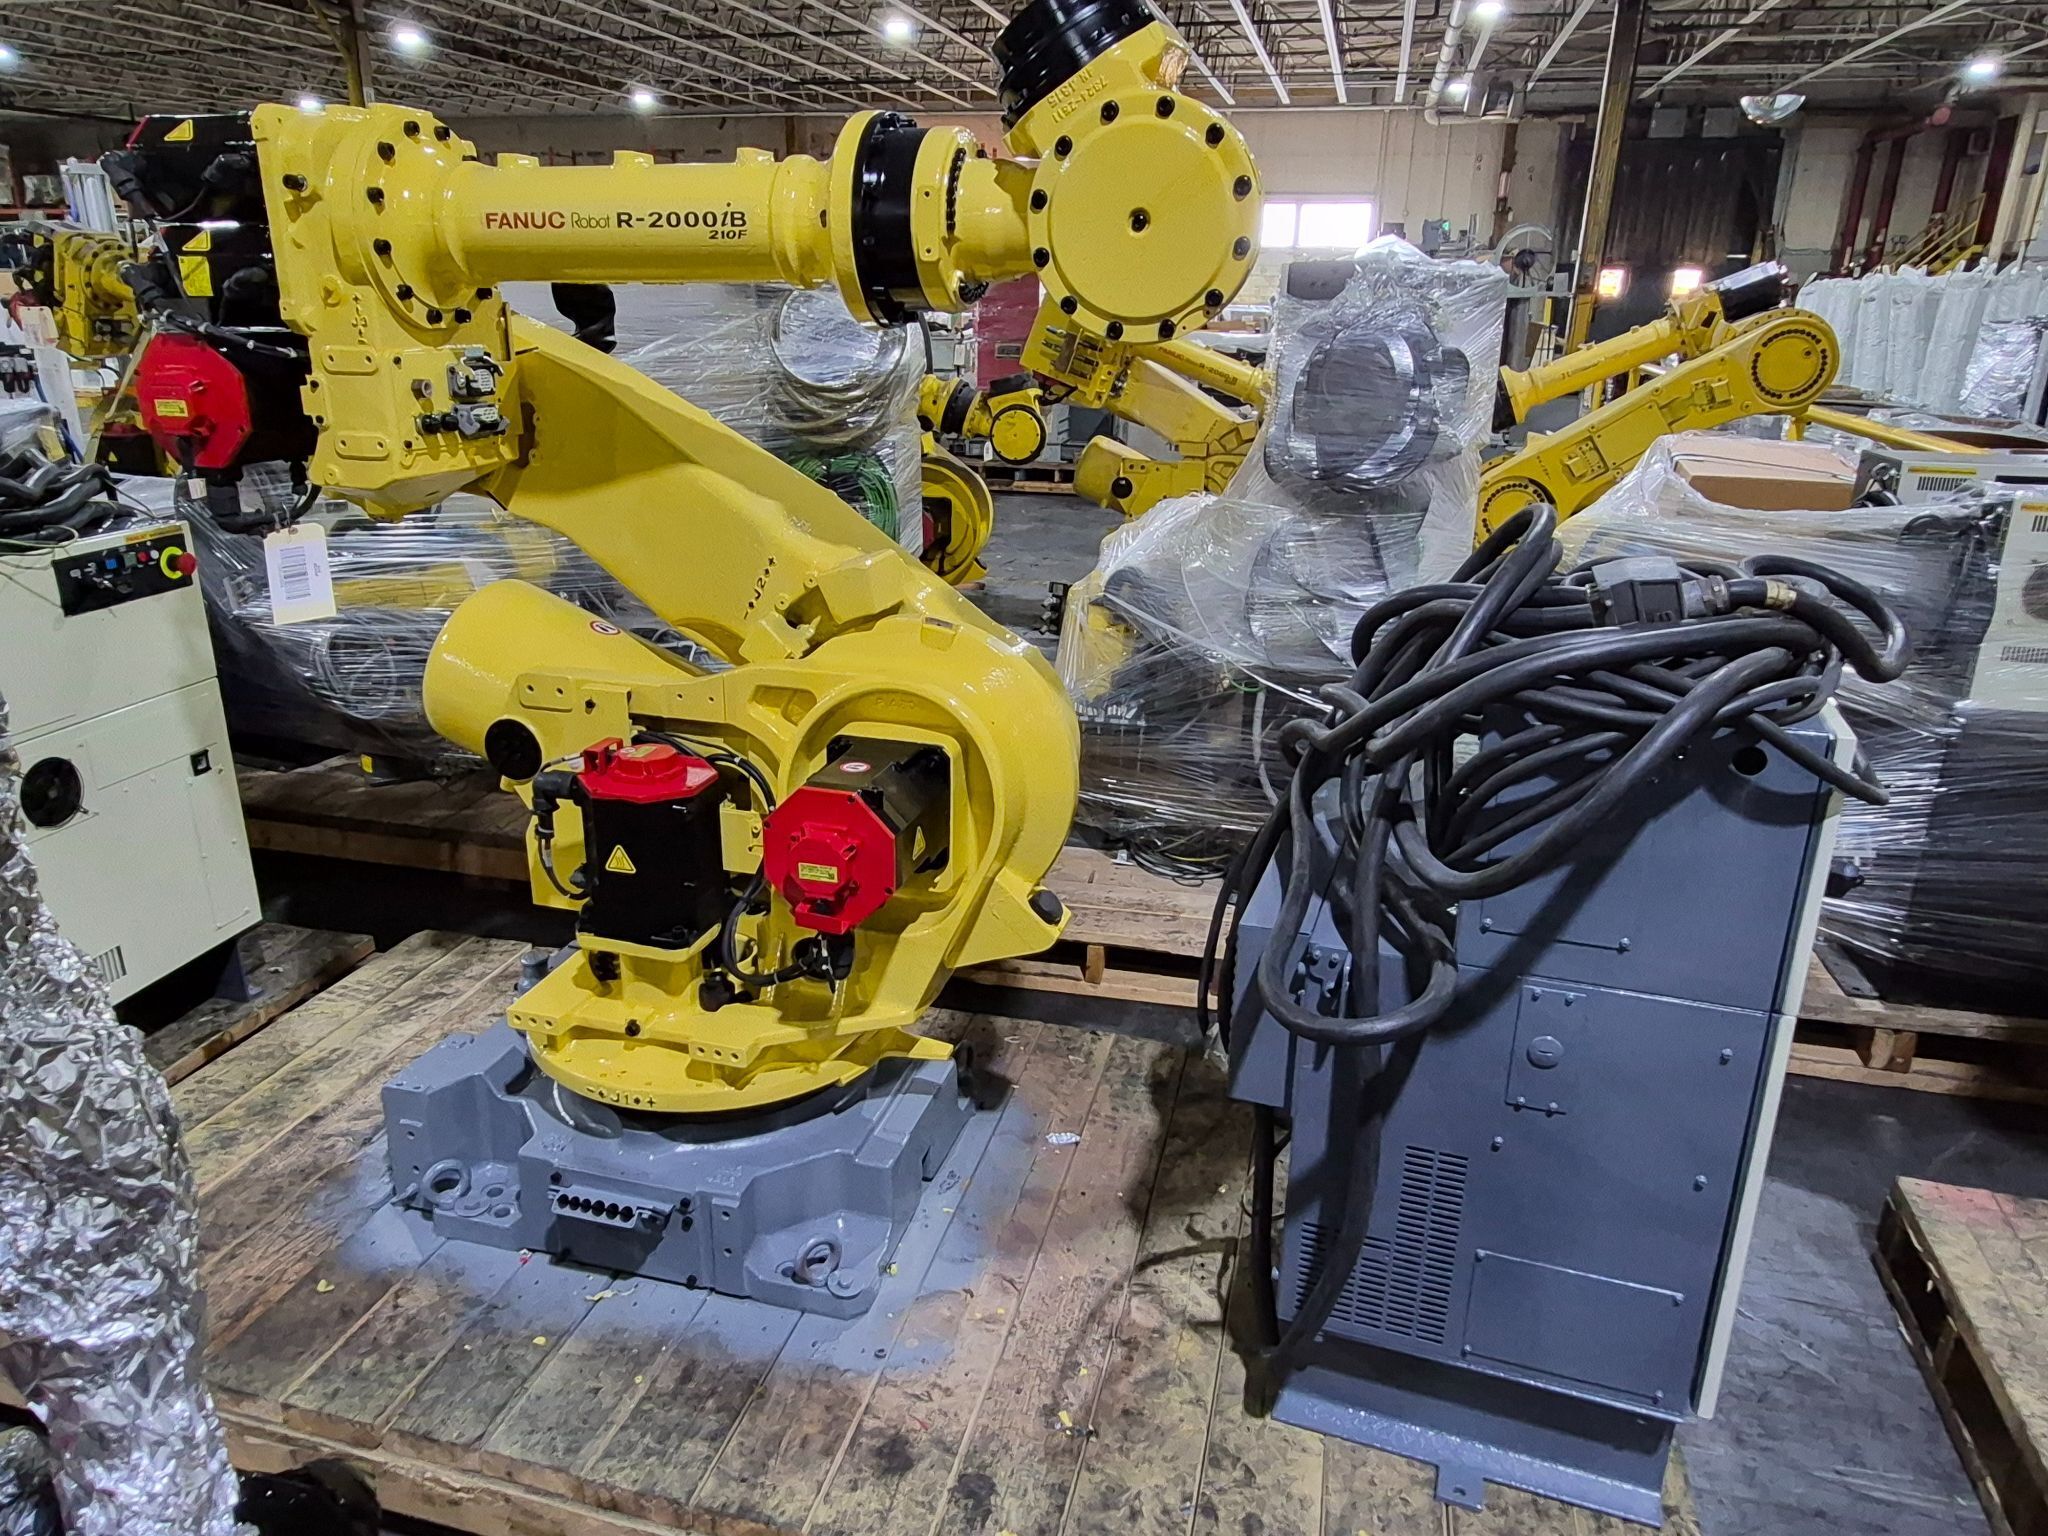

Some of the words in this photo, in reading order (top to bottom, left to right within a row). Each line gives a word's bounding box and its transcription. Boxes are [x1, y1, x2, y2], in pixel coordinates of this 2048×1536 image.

[485, 211, 566, 230] FANUC
[571, 211, 610, 229] Robot
[616, 201, 747, 229] R-2000iB
[708, 229, 748, 240] 210F
[610, 1091, 629, 1105] J1
